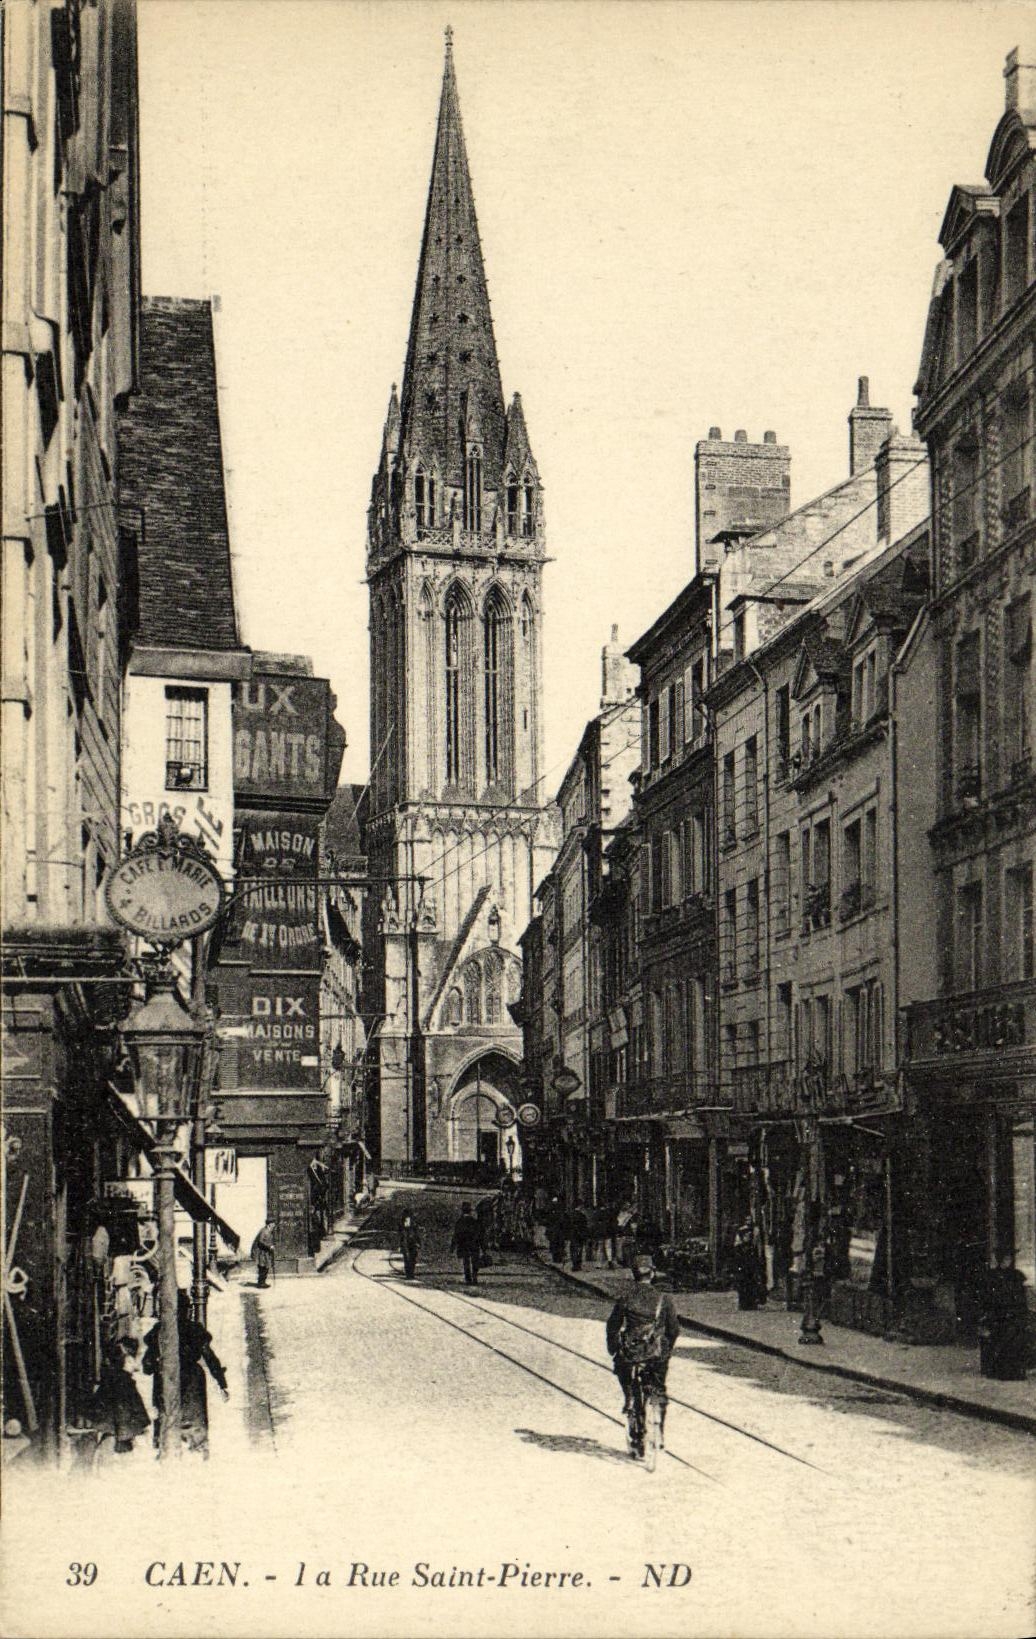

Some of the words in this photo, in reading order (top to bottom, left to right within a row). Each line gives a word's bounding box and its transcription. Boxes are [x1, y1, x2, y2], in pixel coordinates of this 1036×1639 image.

[250, 831, 316, 859] MAISON
[132, 902, 212, 931] BILLARDS
[252, 997, 306, 1016] DIX
[253, 1050, 301, 1063] VENTE
